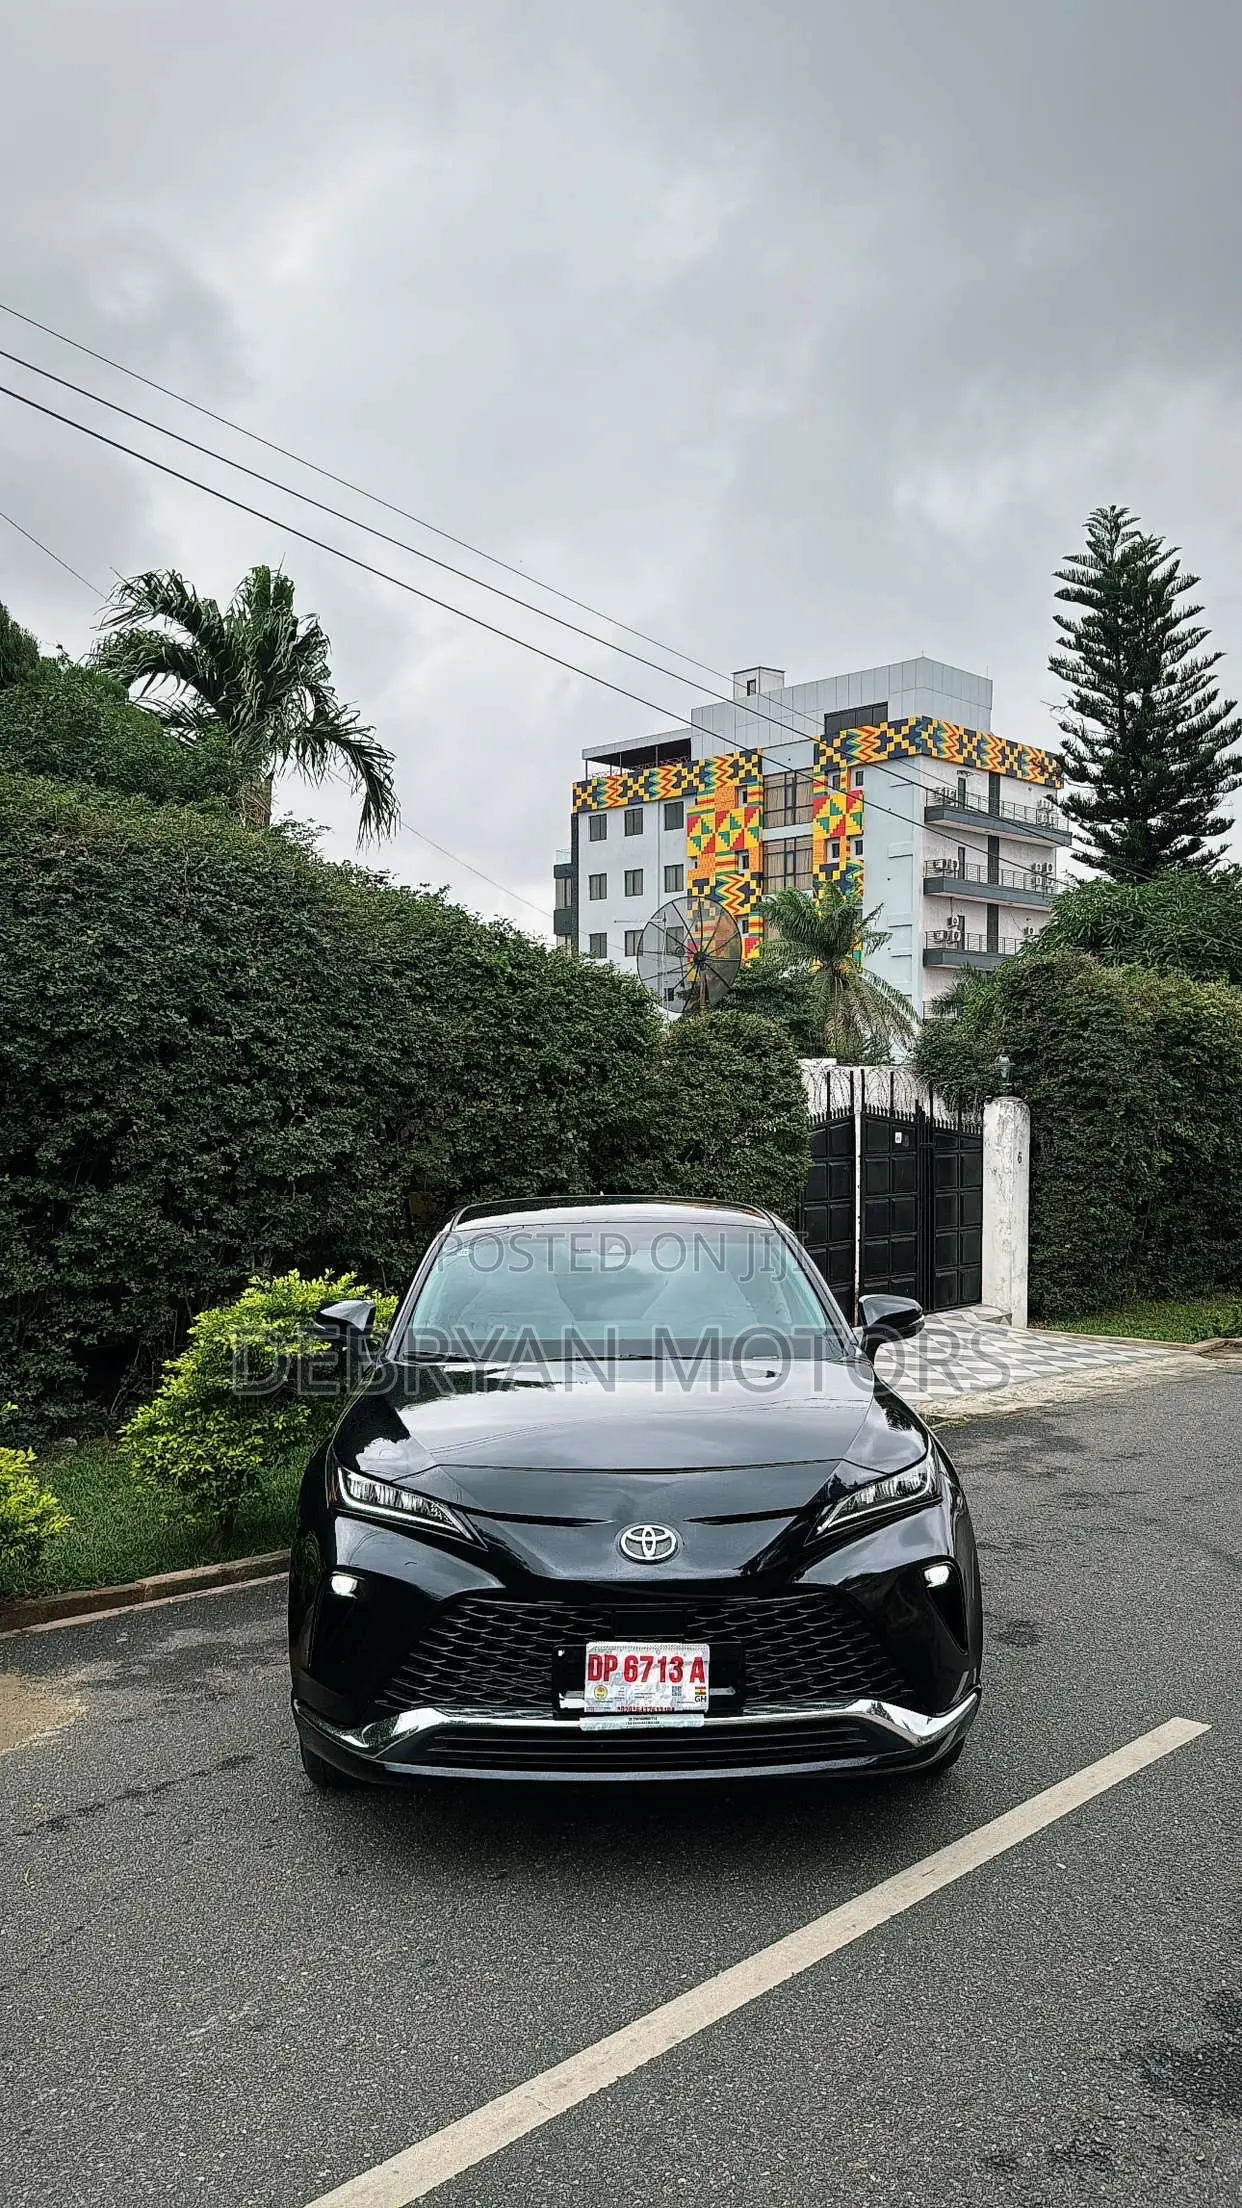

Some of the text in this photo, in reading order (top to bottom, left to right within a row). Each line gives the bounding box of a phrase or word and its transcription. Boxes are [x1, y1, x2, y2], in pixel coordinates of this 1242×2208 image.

[588, 1654, 706, 1683] DP 6713 A
